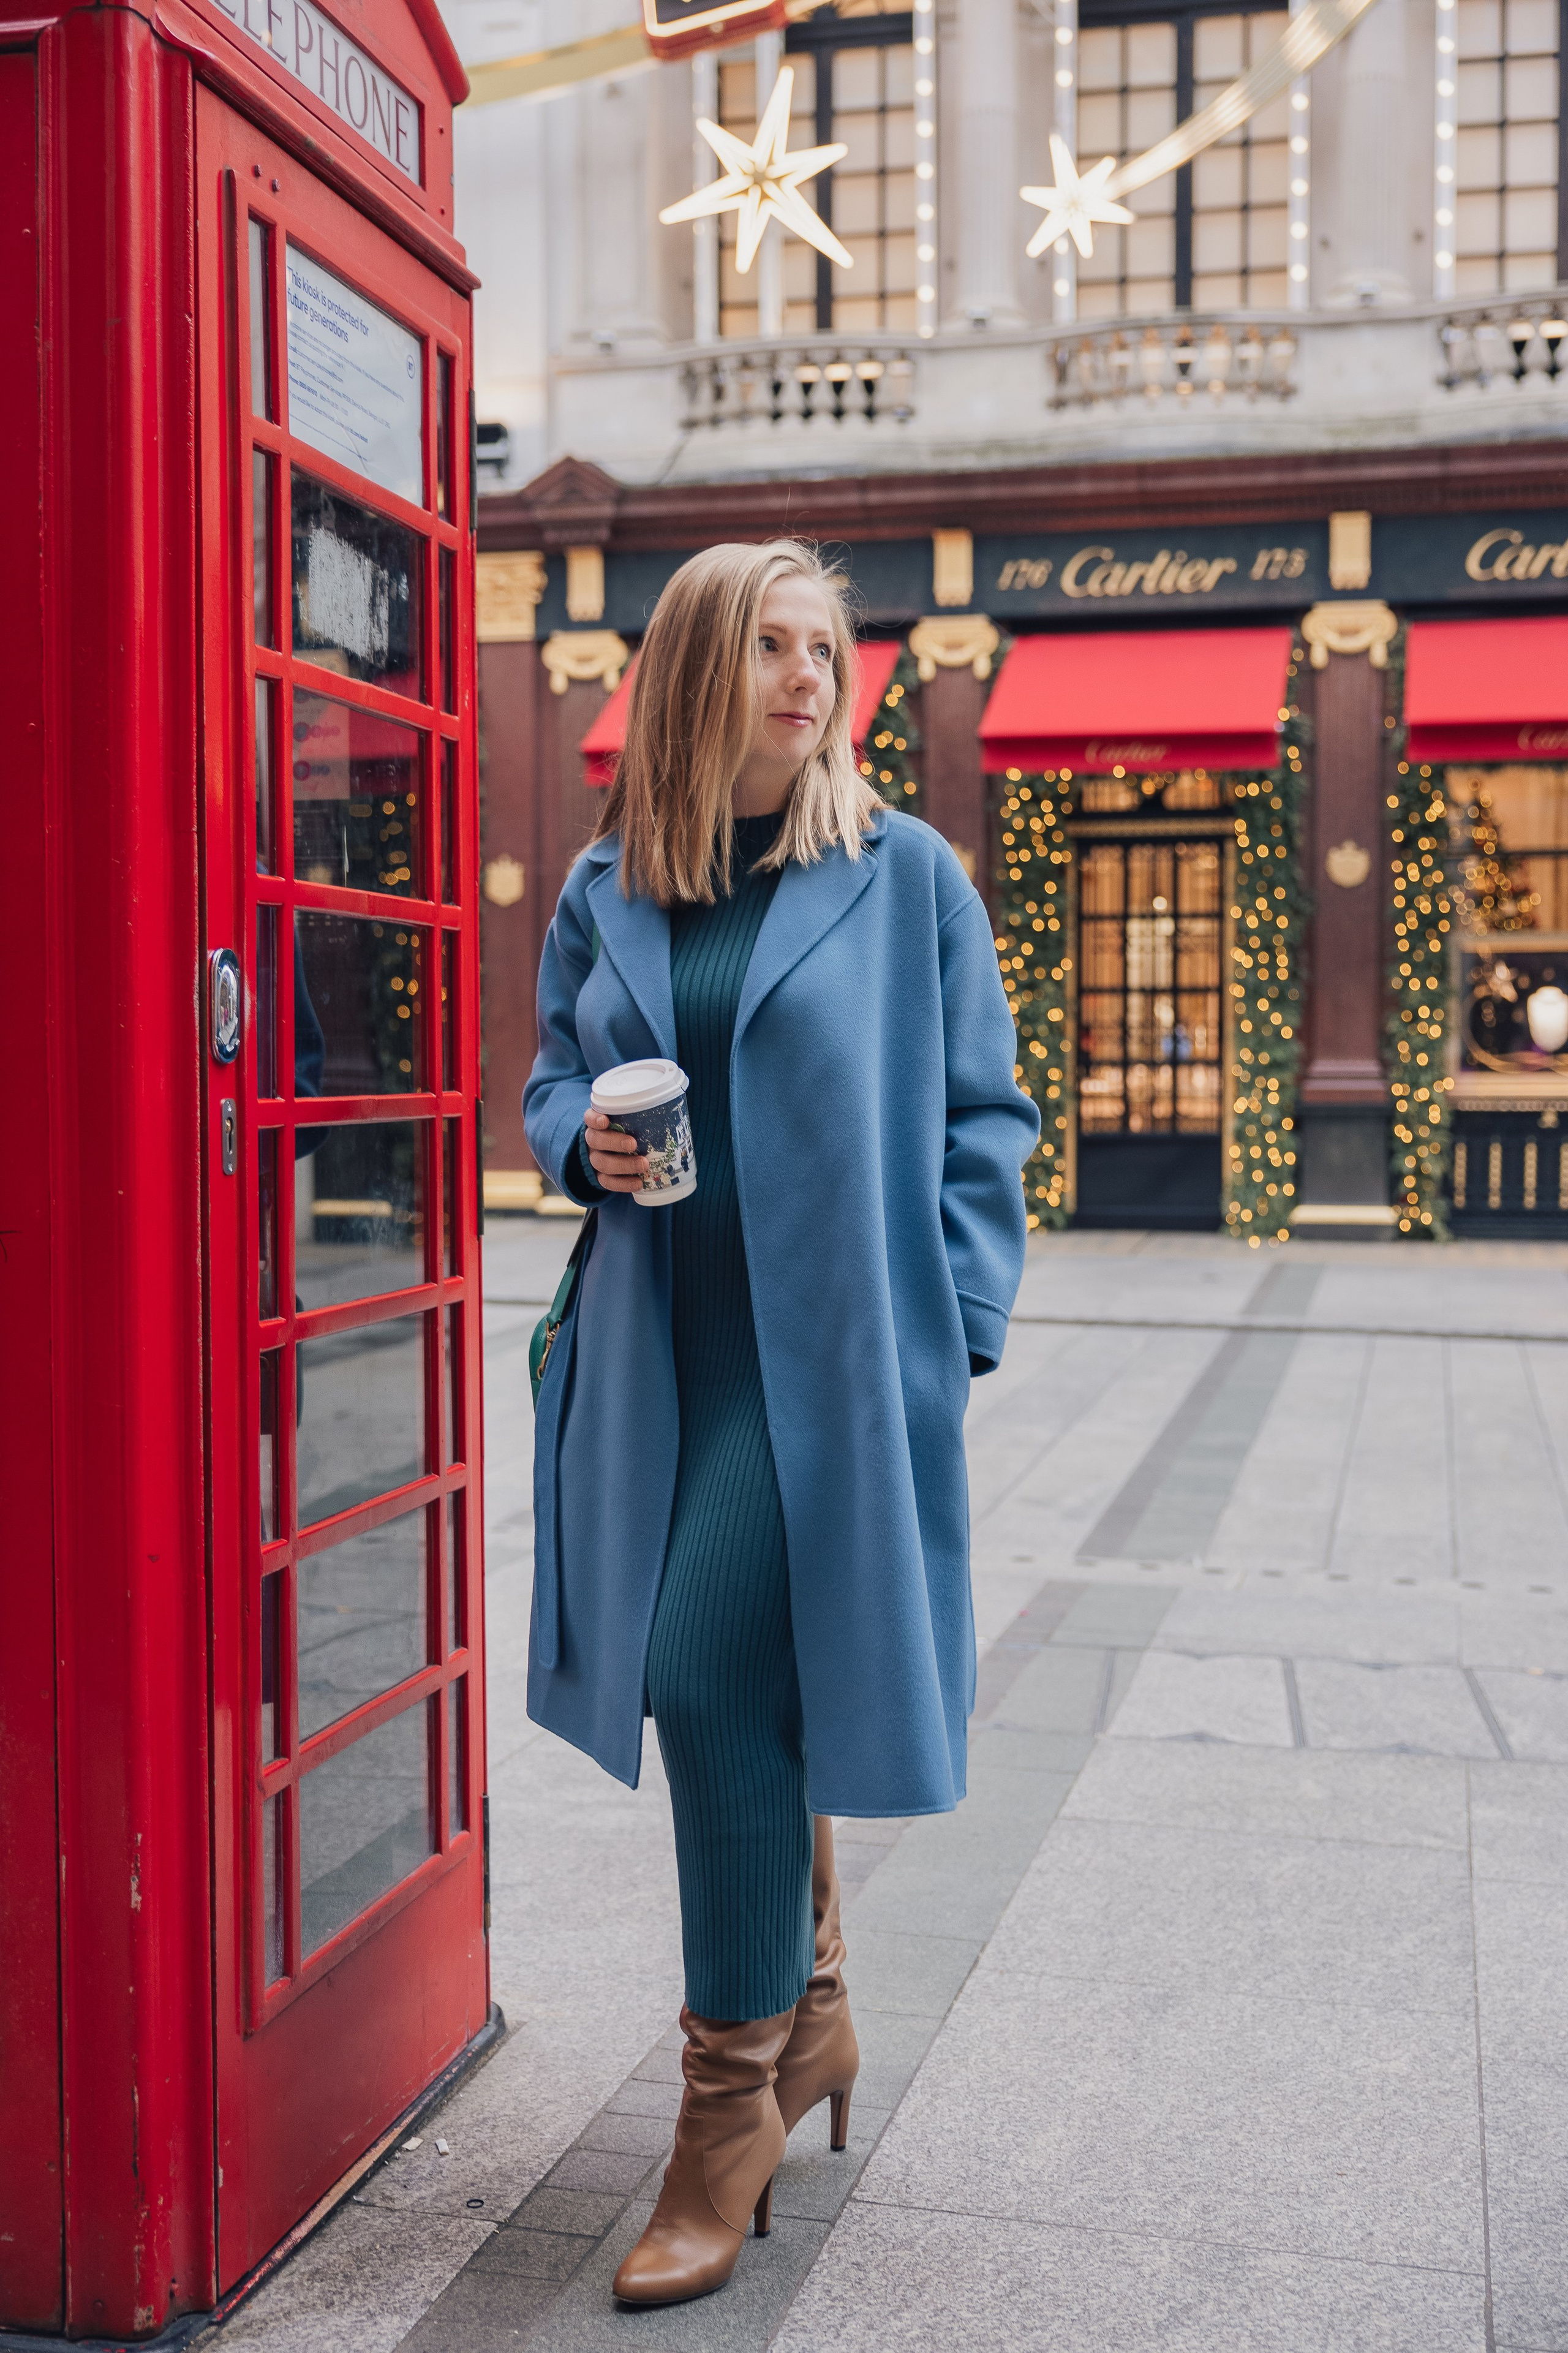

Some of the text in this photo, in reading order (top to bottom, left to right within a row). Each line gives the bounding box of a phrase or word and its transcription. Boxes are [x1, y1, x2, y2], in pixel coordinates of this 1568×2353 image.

[216, 0, 411, 172] LEPHONE
[287, 265, 369, 338] This kiosk is protected for
[287, 287, 349, 343] future generations
[1060, 545, 1238, 598] Cartier
[1084, 739, 1169, 764] Cartier
